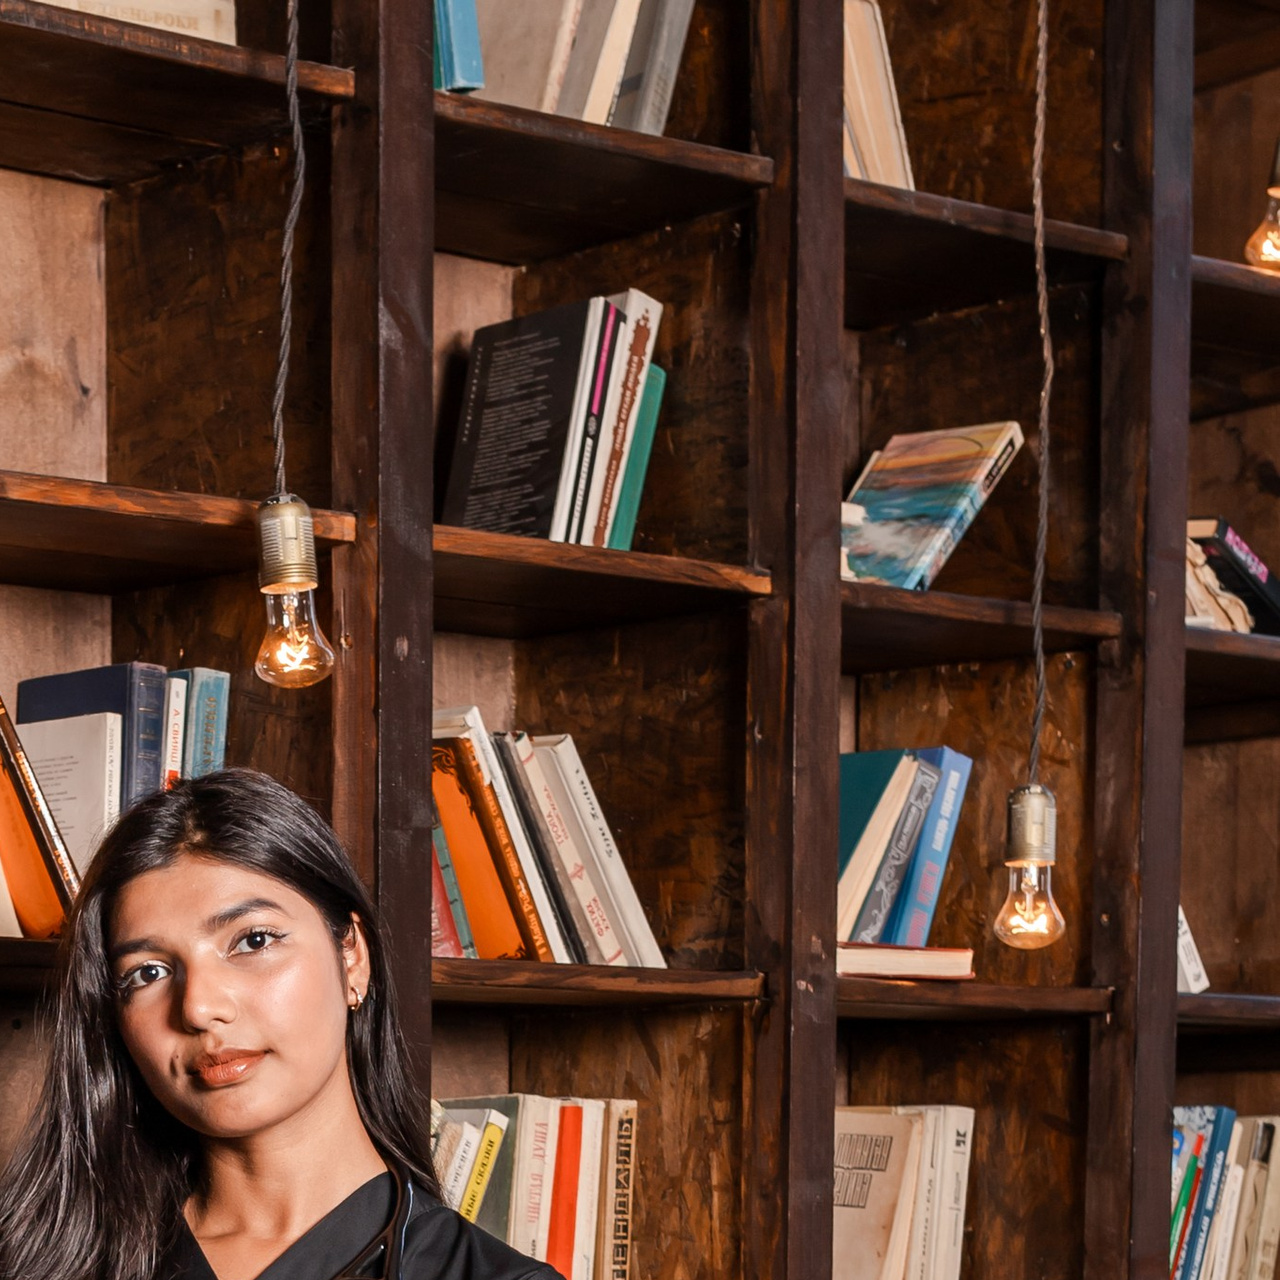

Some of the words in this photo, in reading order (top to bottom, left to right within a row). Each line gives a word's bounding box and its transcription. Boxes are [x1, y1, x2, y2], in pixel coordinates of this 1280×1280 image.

[546, 811, 564, 847] ТРОПА
[585, 899, 604, 938] ФАТИХ
[531, 1120, 549, 1162] ДУША
[473, 1139, 496, 1186] СКАЗКИ
[524, 1172, 543, 1223] ЧИСТАЯ
